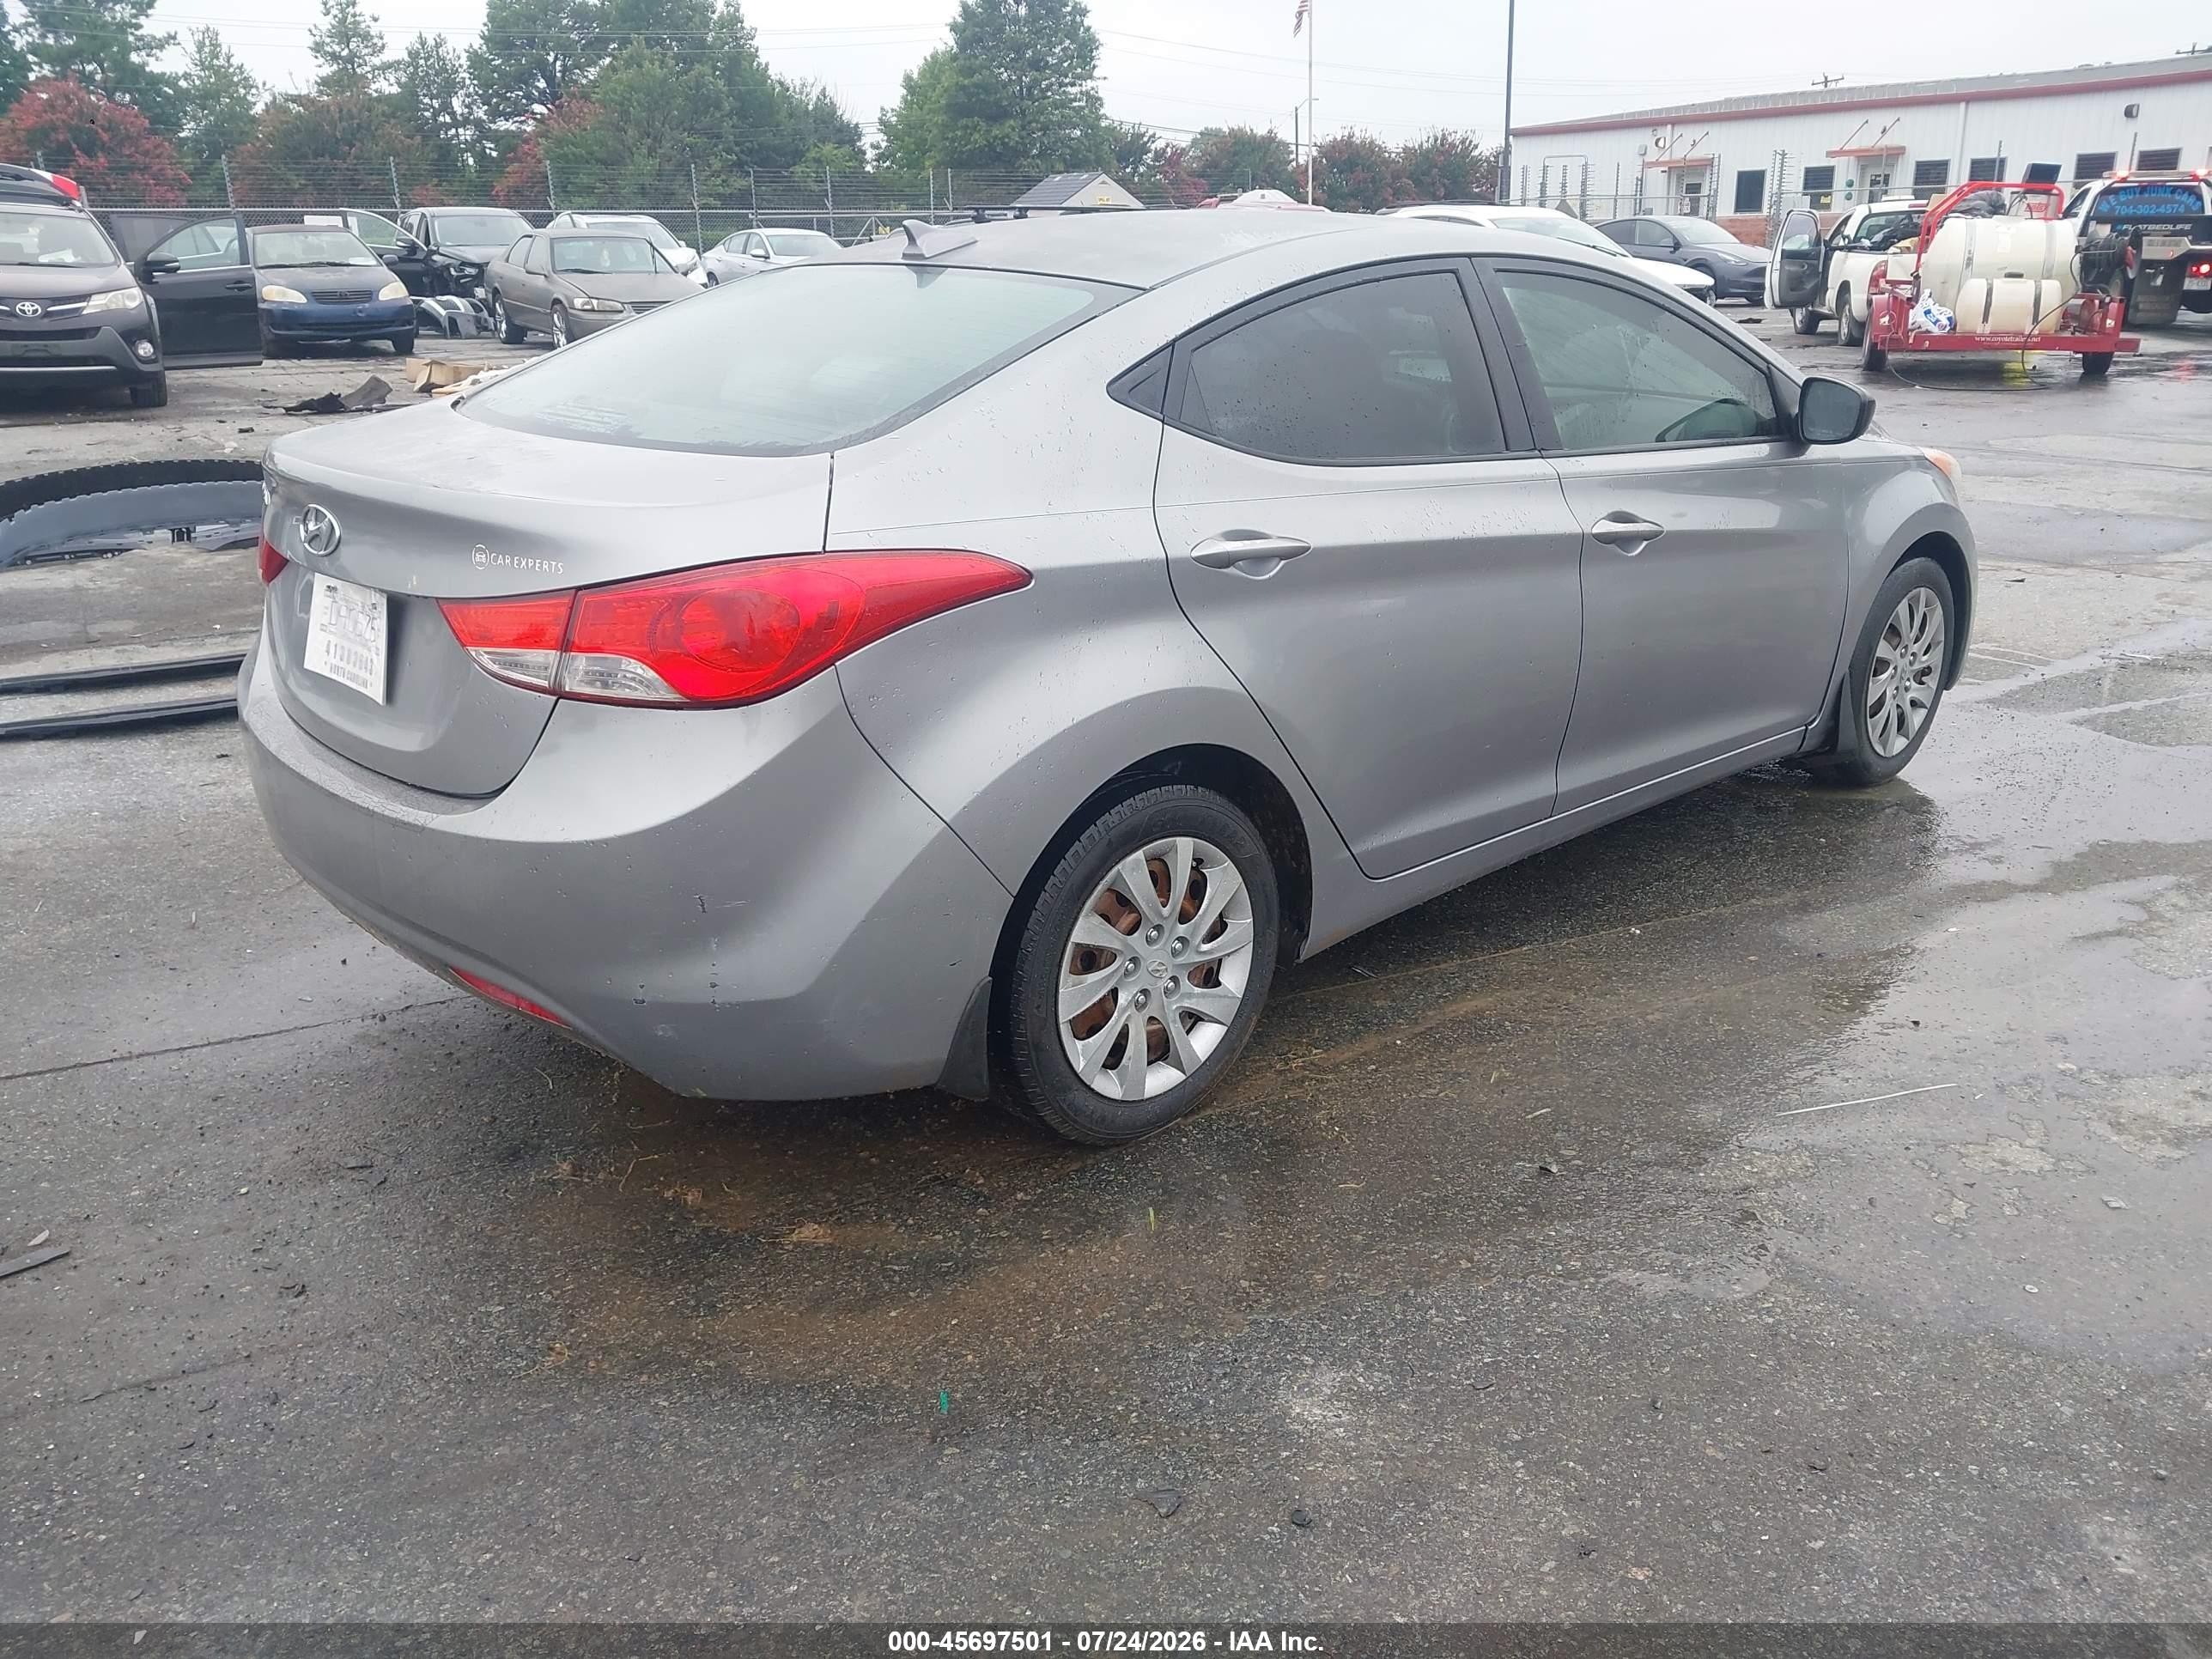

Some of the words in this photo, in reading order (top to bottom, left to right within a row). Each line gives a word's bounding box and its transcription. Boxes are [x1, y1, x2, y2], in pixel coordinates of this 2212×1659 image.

[2098, 194, 2118, 212] WE
[2118, 187, 2141, 202] BUY
[2143, 186, 2172, 198] JUNK
[2175, 189, 2202, 210] CARS
[2115, 204, 2185, 215] 704-302-4574
[490, 552, 512, 568] CAR
[514, 556, 564, 574] EXPERTS
